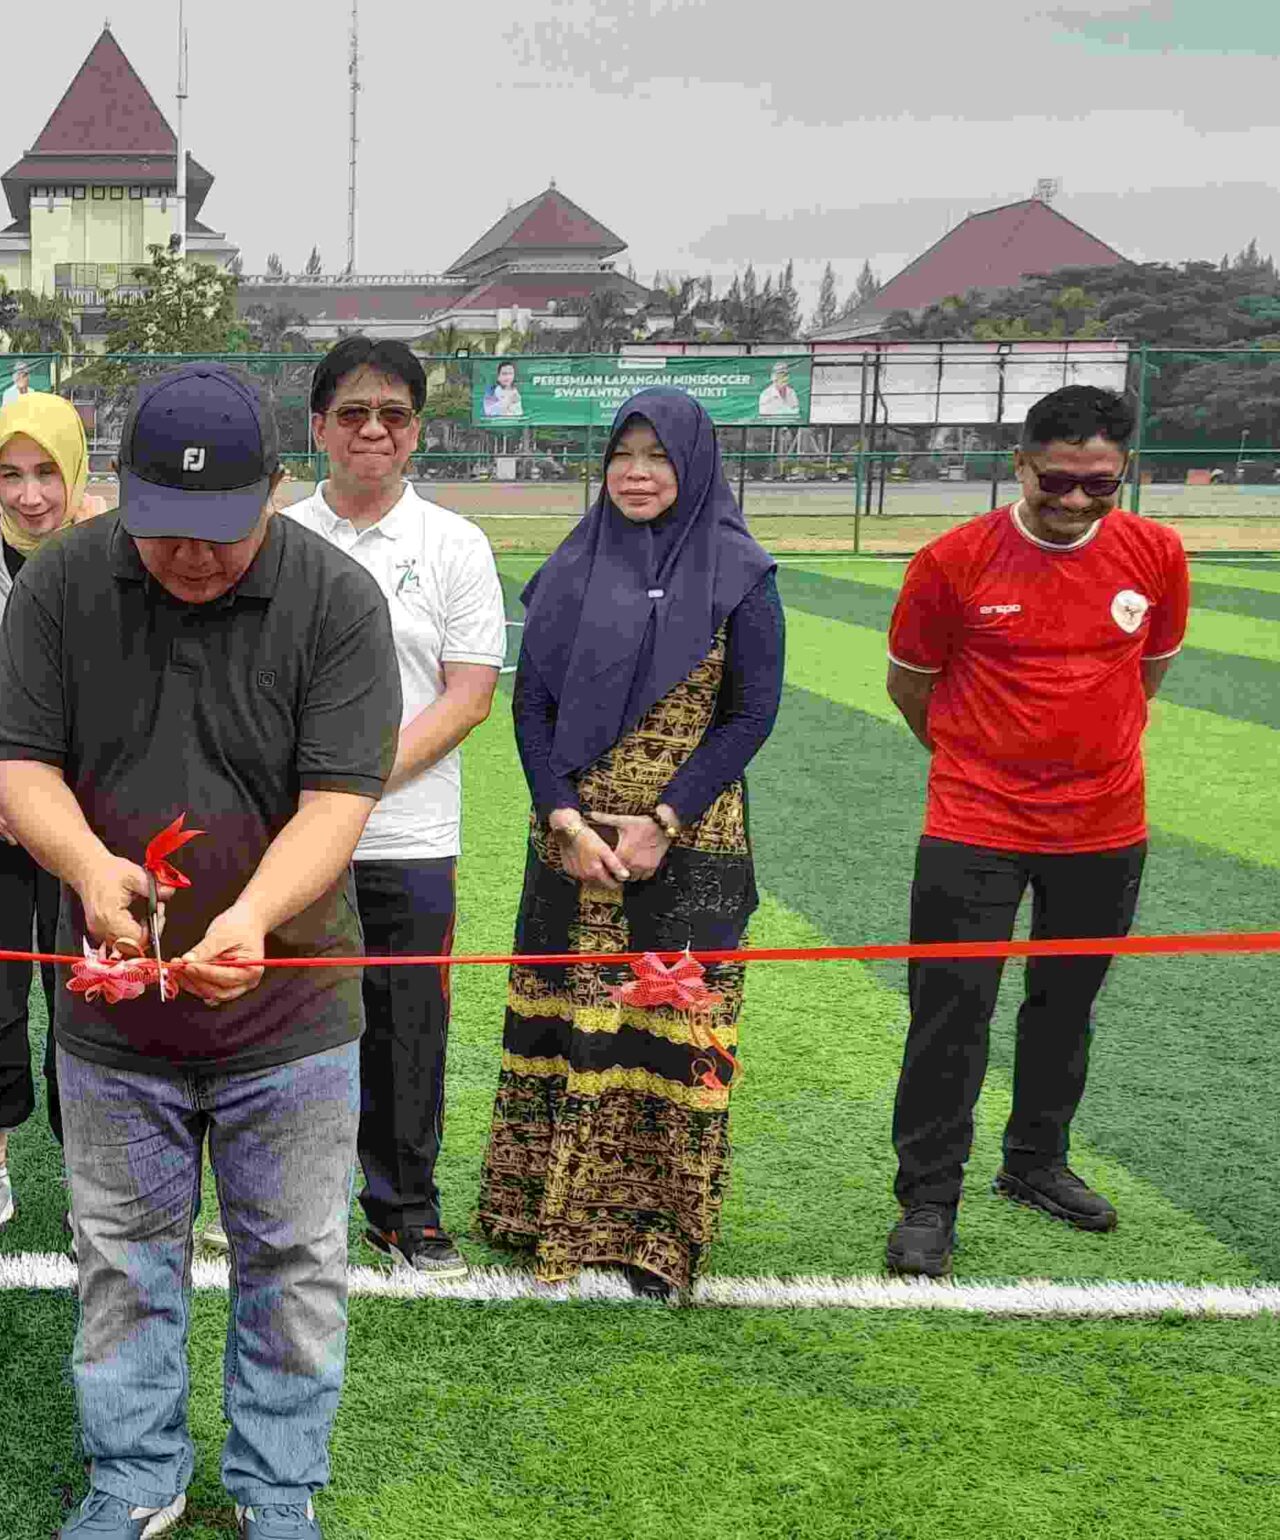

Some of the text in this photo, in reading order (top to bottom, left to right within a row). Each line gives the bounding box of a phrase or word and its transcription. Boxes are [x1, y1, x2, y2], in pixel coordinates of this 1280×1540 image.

[532, 375, 751, 386] PERESMIAN LAPANGAN MINISOCCER
[554, 387, 631, 398] SWATANTRA
[182, 447, 206, 472] FJ
